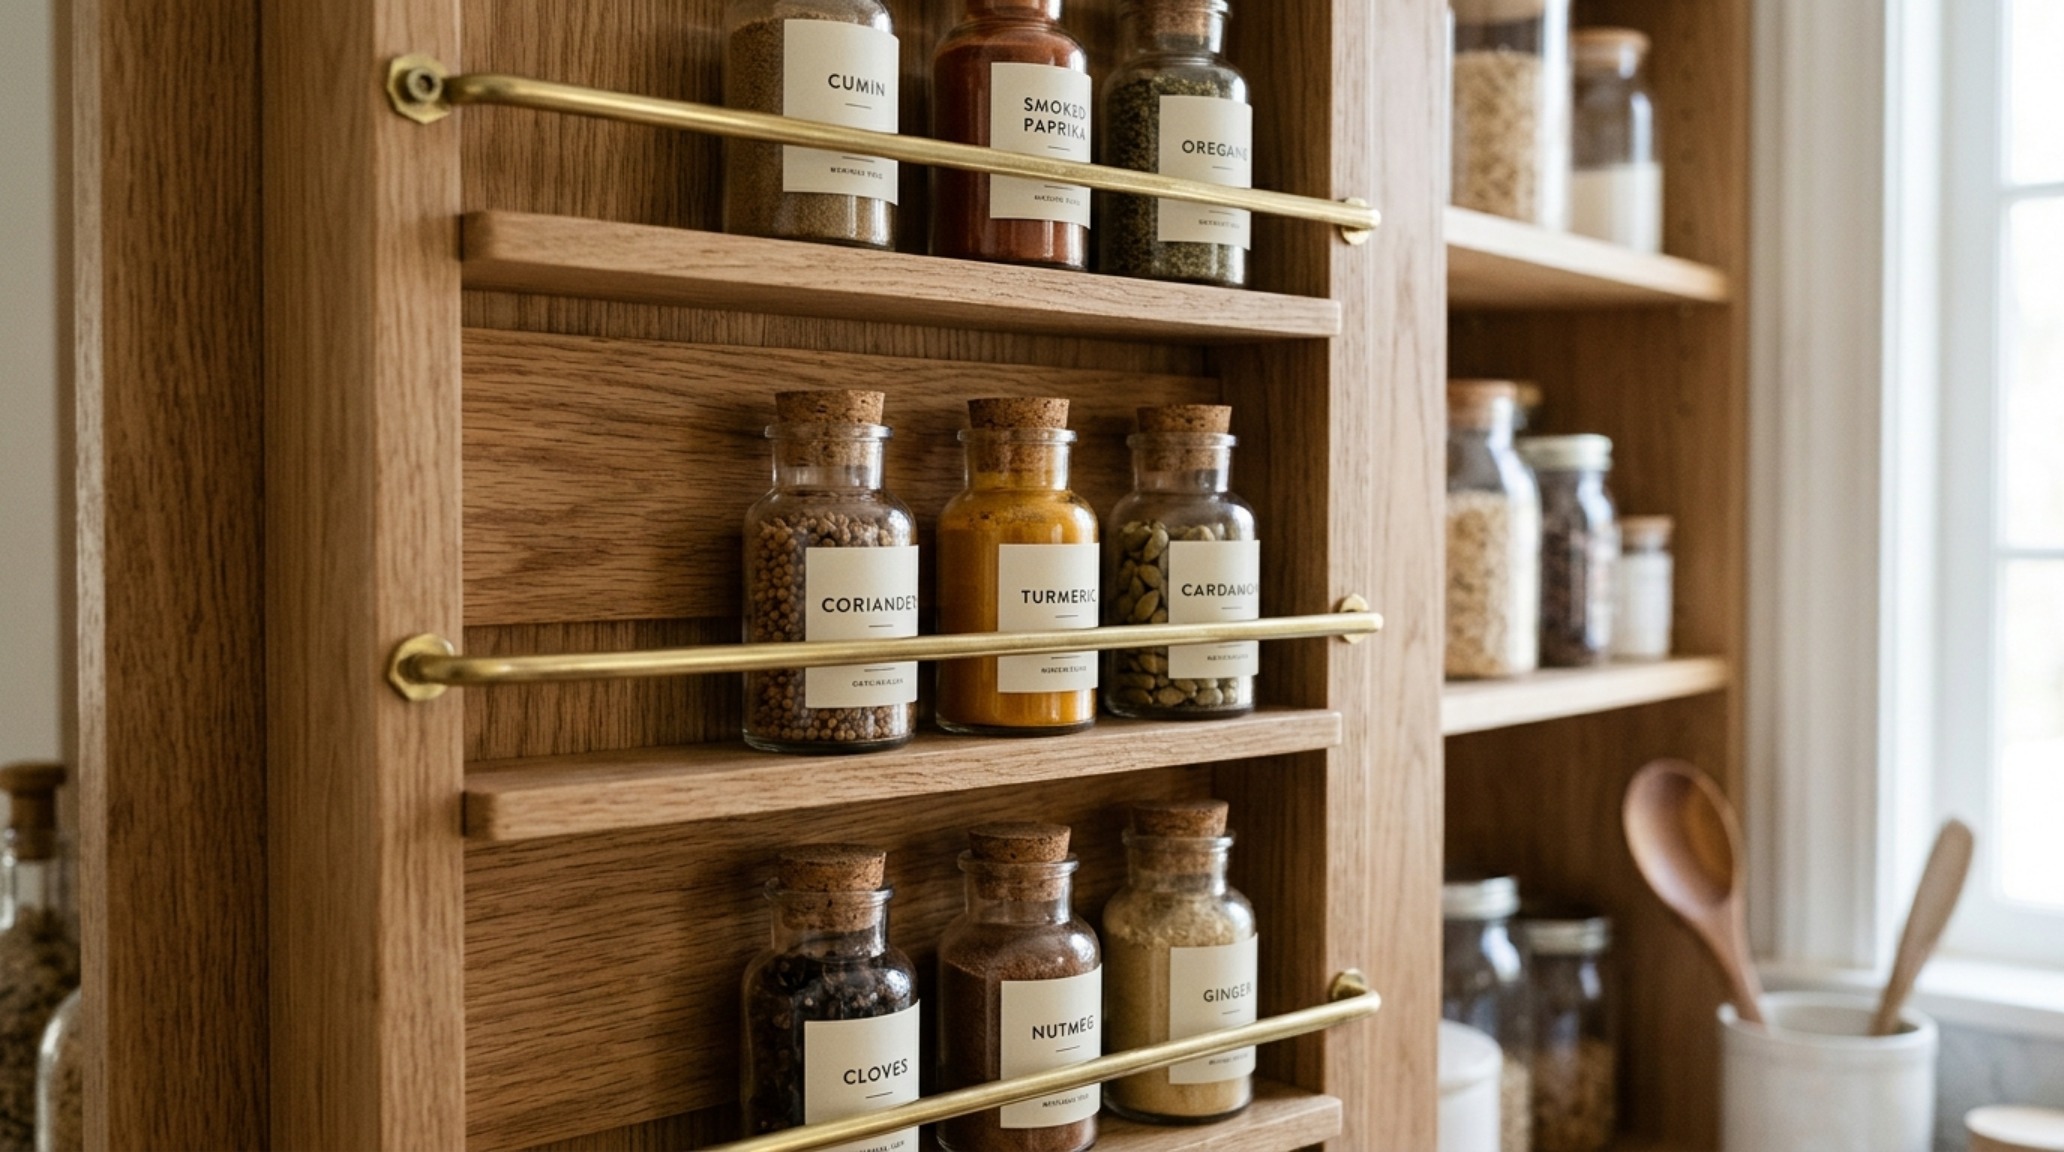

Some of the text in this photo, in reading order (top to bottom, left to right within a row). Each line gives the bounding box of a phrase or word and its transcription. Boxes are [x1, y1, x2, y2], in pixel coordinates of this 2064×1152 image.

[828, 73, 885, 97] CUMIN
[1024, 97, 1087, 121] SMOKED
[1024, 117, 1086, 141] PAPRIKA
[1021, 589, 1096, 604] TURMERIC
[1203, 982, 1252, 1002] GINGER
[1032, 1015, 1094, 1040] NUTMEG
[843, 1058, 908, 1085] CLOVES
